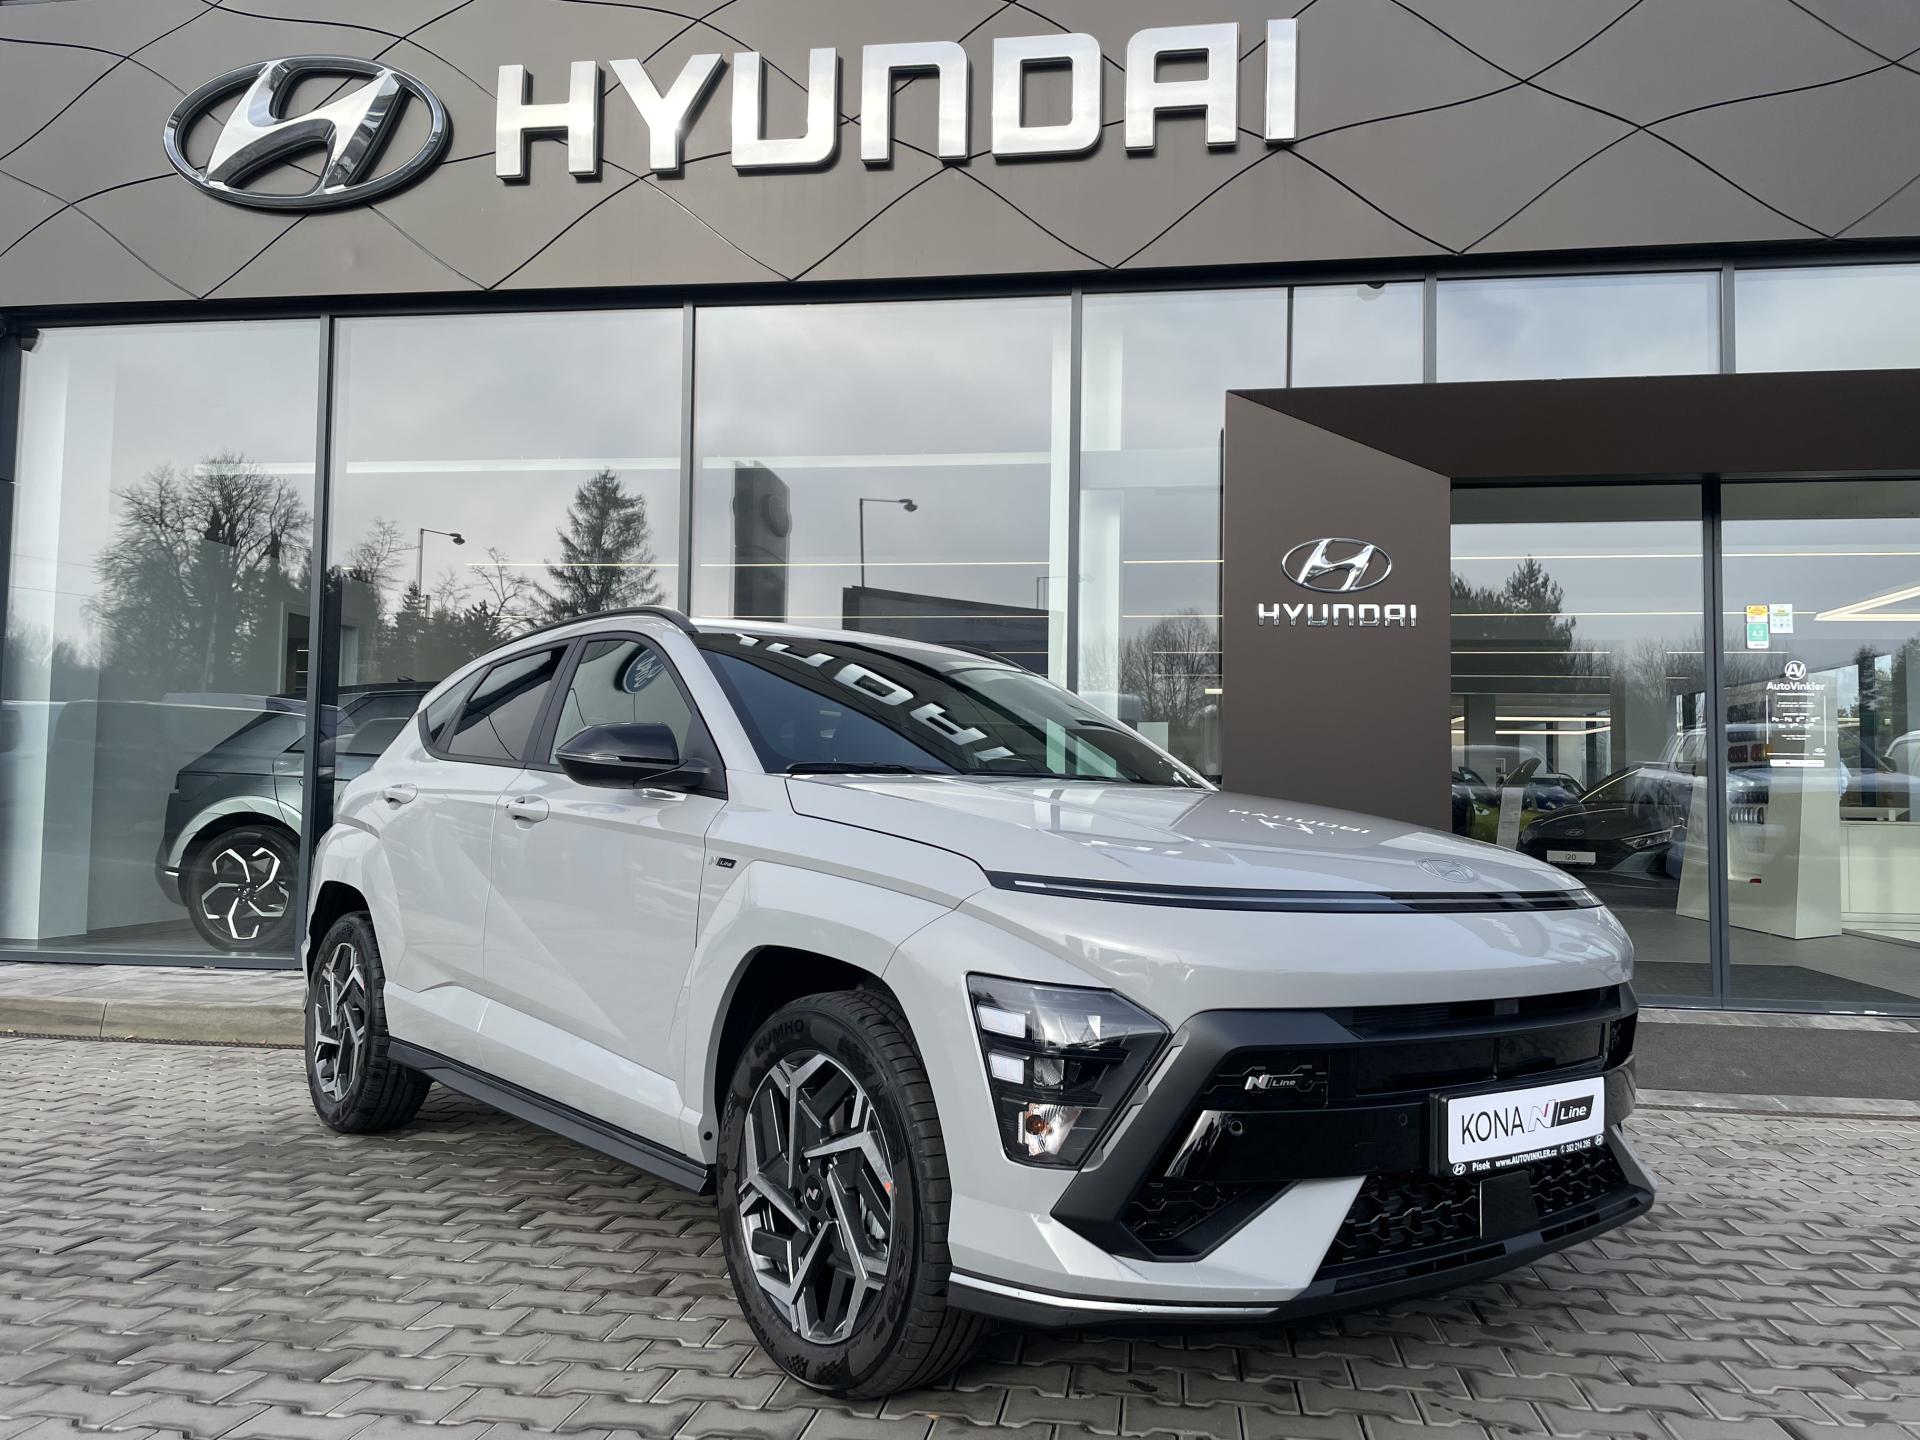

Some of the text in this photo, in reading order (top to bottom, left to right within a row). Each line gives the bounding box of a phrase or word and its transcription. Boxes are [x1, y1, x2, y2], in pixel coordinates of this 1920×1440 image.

[494, 18, 1300, 184] HYUNDAI
[1257, 603, 1417, 627] HYUNDAI
[1766, 682, 1825, 691] AutoVinkler
[754, 1019, 804, 1058] KUMHO
[1272, 1079, 1296, 1087] Line
[1461, 1106, 1525, 1144] KONA
[1560, 1105, 1587, 1120] Line
